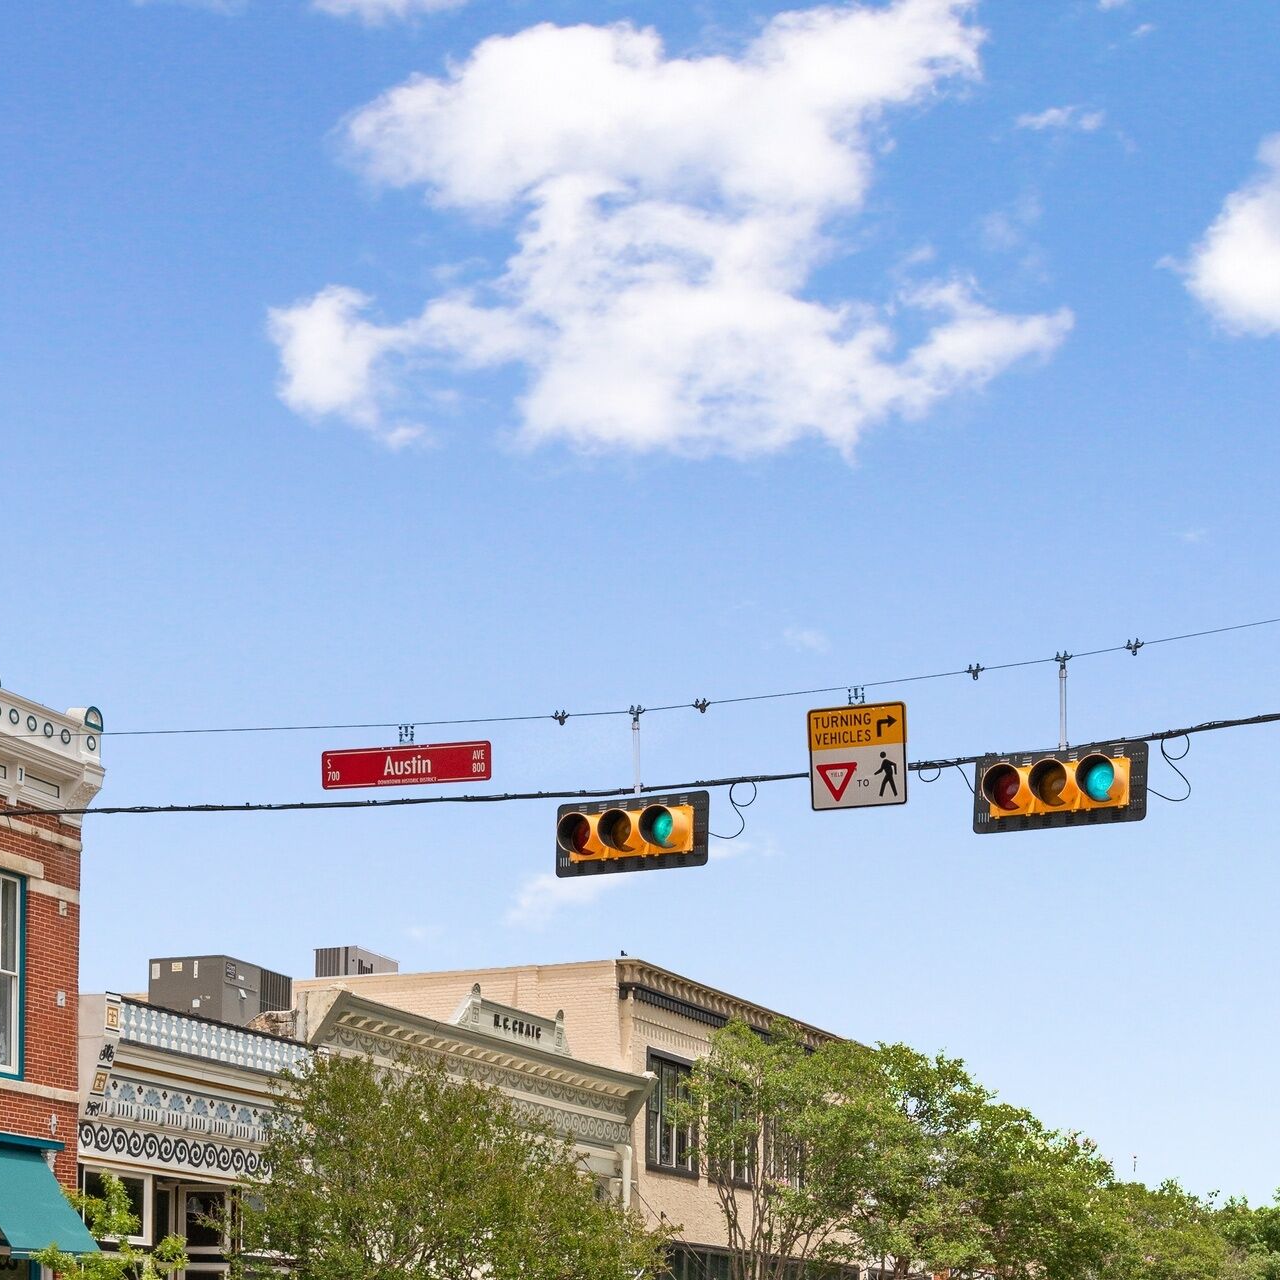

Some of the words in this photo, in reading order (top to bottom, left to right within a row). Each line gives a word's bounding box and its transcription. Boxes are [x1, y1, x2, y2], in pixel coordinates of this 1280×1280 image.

[814, 713, 871, 729] TURNING
[815, 729, 871, 746] VEHICLES
[472, 750, 485, 760] AVE
[327, 759, 332, 769] S
[383, 755, 432, 776] Austin
[472, 762, 485, 773] 800
[327, 771, 340, 782] 700
[857, 779, 869, 787] TO
